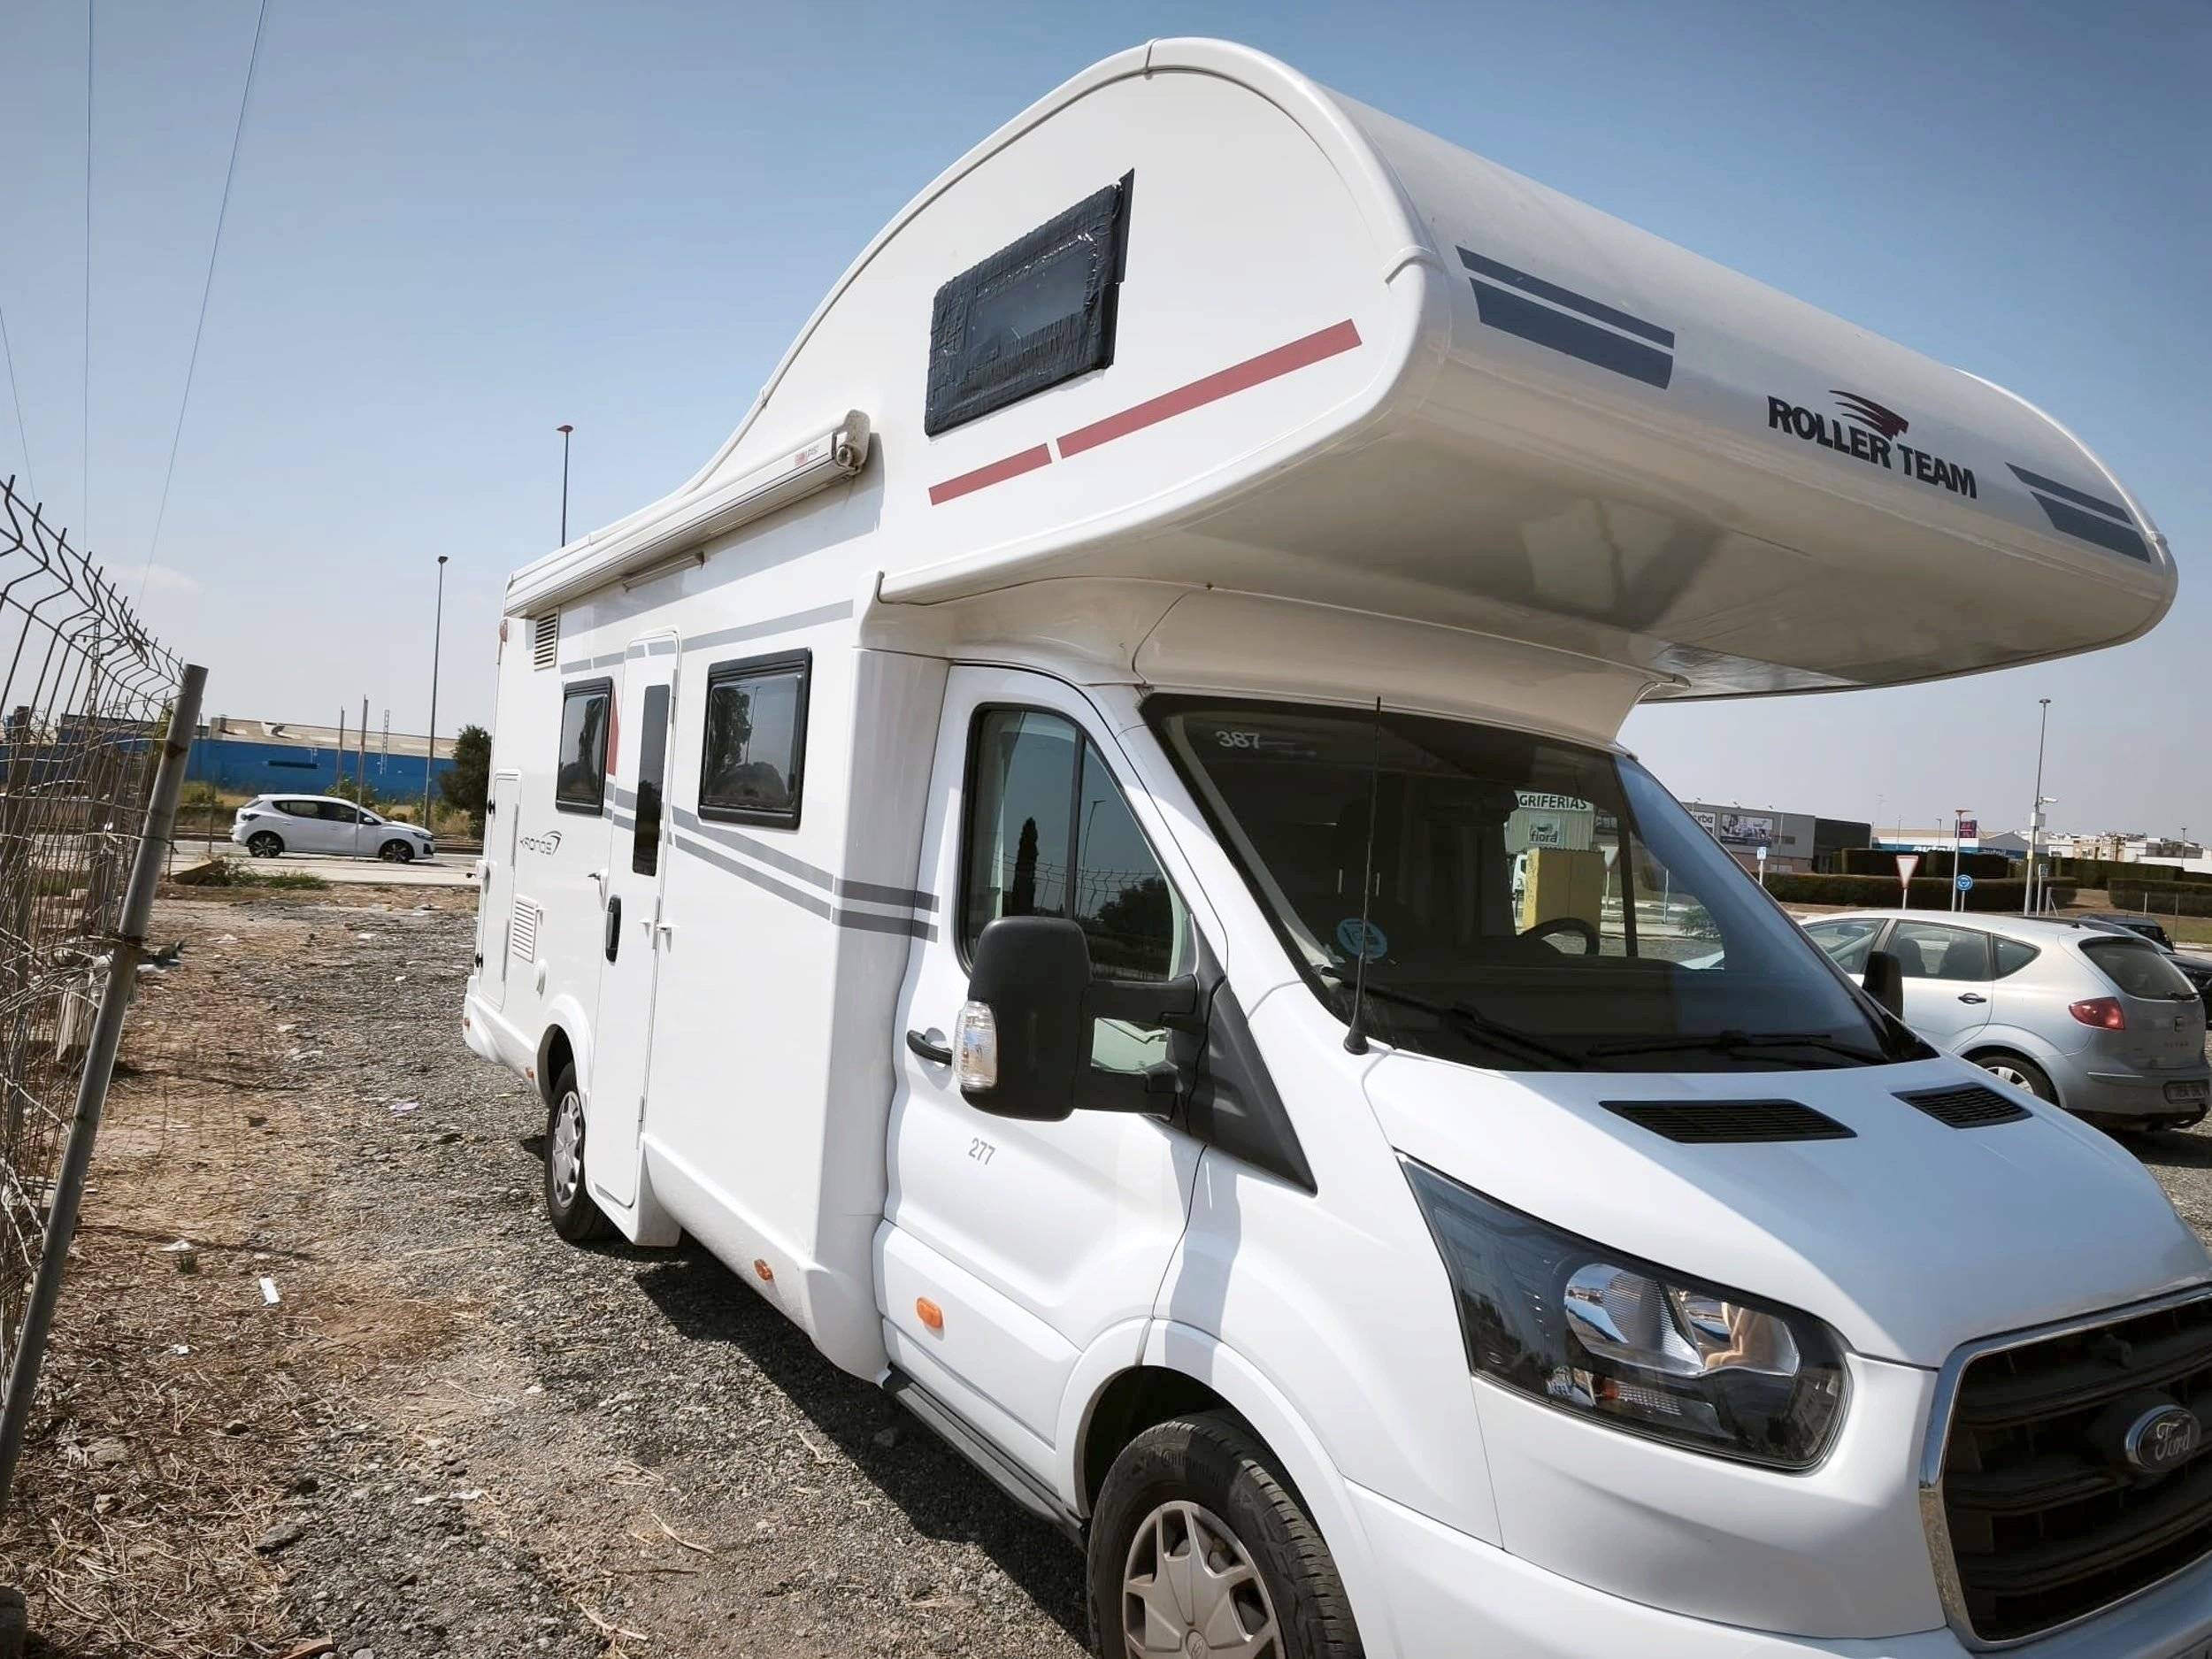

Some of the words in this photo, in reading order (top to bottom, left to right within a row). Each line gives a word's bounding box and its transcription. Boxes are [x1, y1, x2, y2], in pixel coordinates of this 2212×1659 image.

[1768, 396, 1892, 469] ROLLER
[1897, 443, 1978, 500] TEAM
[1216, 731, 1260, 749] 387
[1519, 795, 1587, 810] GRIFERIAS
[968, 1137, 996, 1165] 277
[2155, 1421, 2192, 1461] Ford
